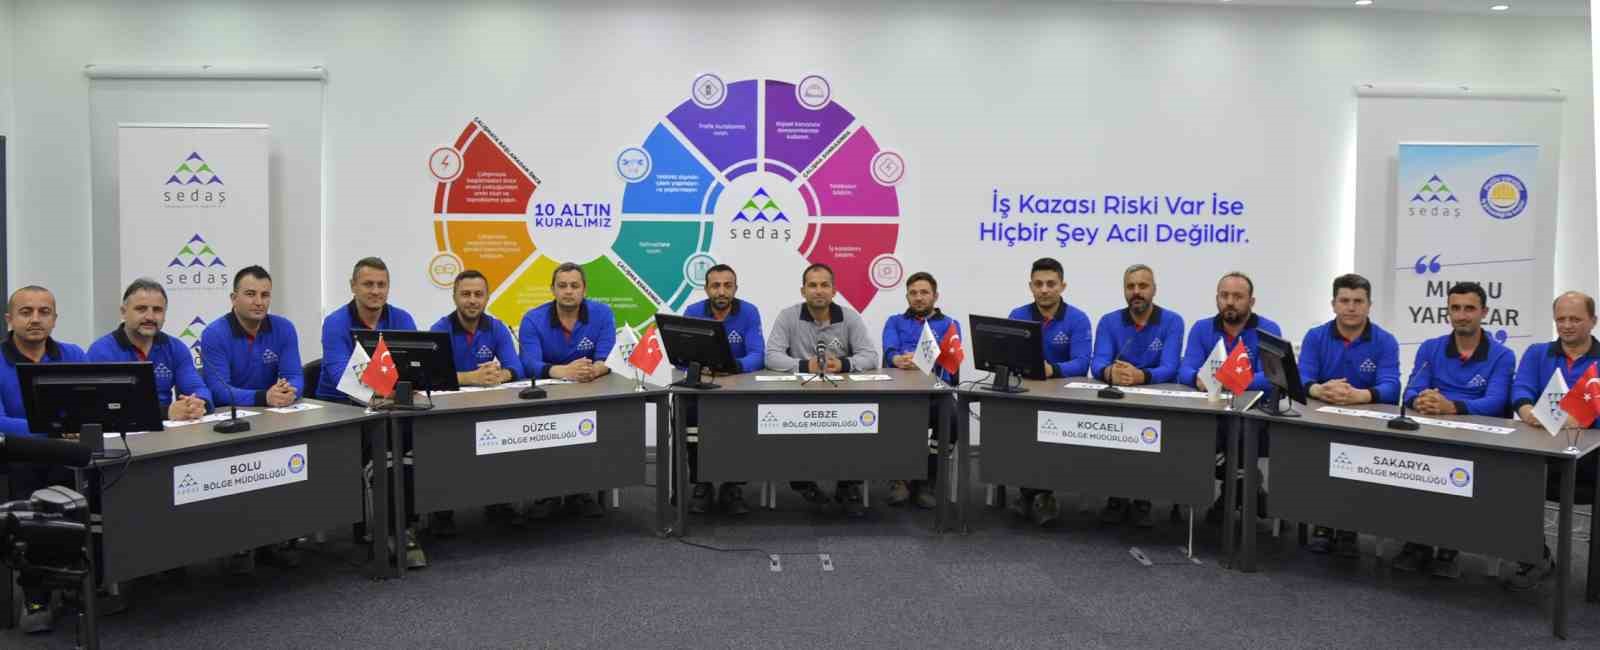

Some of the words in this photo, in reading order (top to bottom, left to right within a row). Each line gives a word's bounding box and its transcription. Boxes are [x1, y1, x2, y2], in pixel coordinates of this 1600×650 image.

[163, 189, 226, 203] sedaş
[535, 203, 555, 217] 10
[561, 203, 611, 217] ALTIN
[992, 189, 1011, 218] İş
[1019, 194, 1096, 214] Kazası
[1104, 195, 1158, 215] Riski
[1165, 196, 1205, 215] Var
[1212, 192, 1244, 215] İse
[1408, 206, 1461, 218] sedaş
[535, 217, 612, 228] KURALIMIZ
[730, 226, 791, 242] sedaş
[980, 222, 1048, 247] Hiçbir
[1056, 223, 1099, 248] Şey
[1106, 223, 1148, 243] Acil
[1156, 223, 1249, 246] Değildir.
[166, 272, 228, 286] sedaş
[803, 410, 839, 419] GEBZE
[522, 422, 558, 434] DÜZCE
[782, 420, 809, 428] BÖLGE
[1077, 420, 1124, 433] KOCAELİ
[501, 436, 528, 446] BÖLGE
[1062, 430, 1088, 440] BÖLGE
[230, 460, 262, 475] BOLU
[1373, 455, 1432, 473] SAKARYA
[1357, 466, 1388, 478] BÖLGE
[203, 479, 233, 492] BÖLGE
